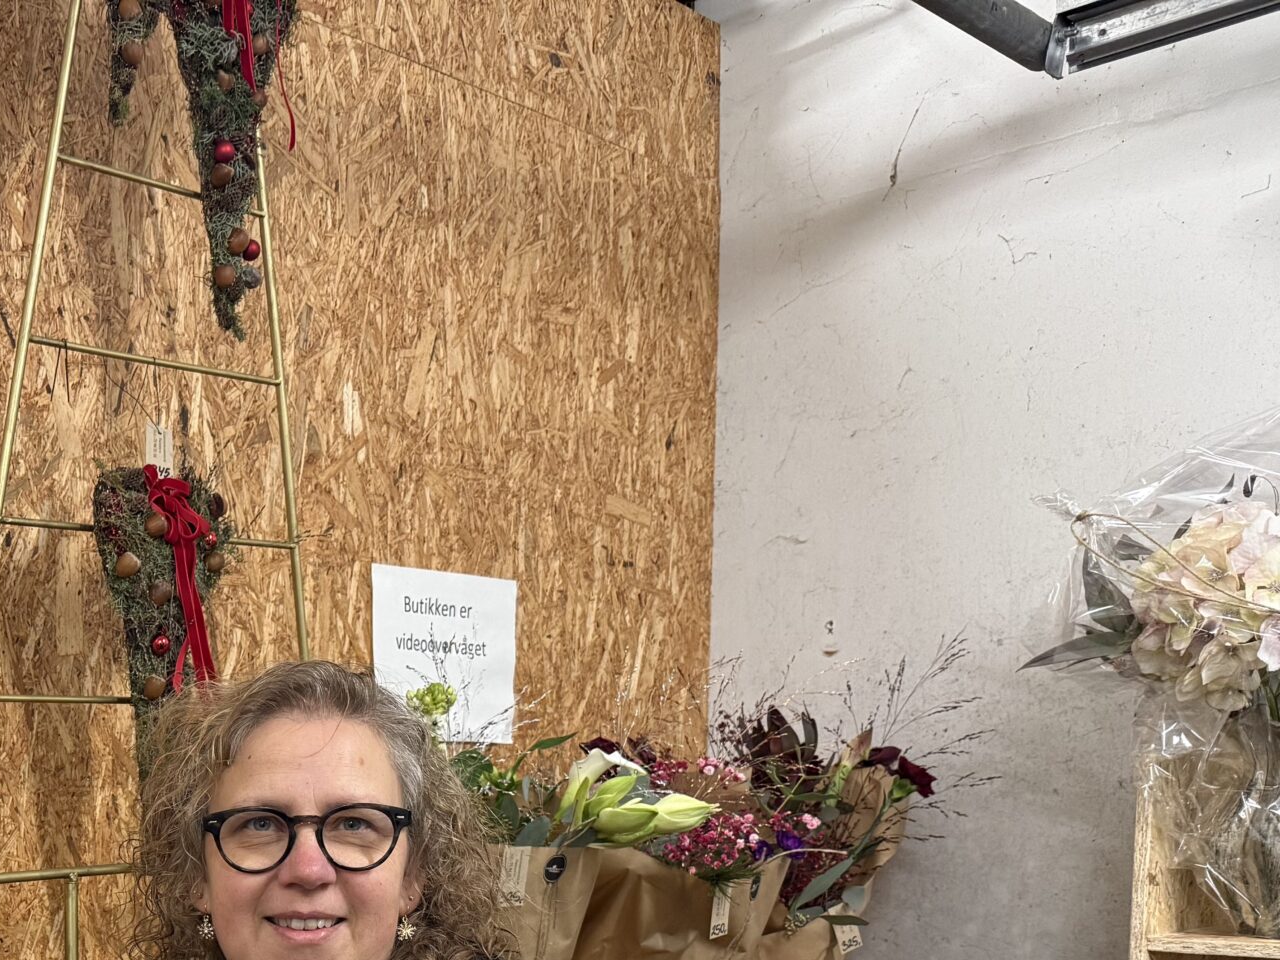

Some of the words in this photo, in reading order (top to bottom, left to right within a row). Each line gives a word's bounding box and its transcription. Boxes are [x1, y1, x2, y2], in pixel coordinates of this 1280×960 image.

[403, 595, 456, 617] Butikken
[459, 605, 473, 618] er
[395, 633, 487, 660] videoovervåget
